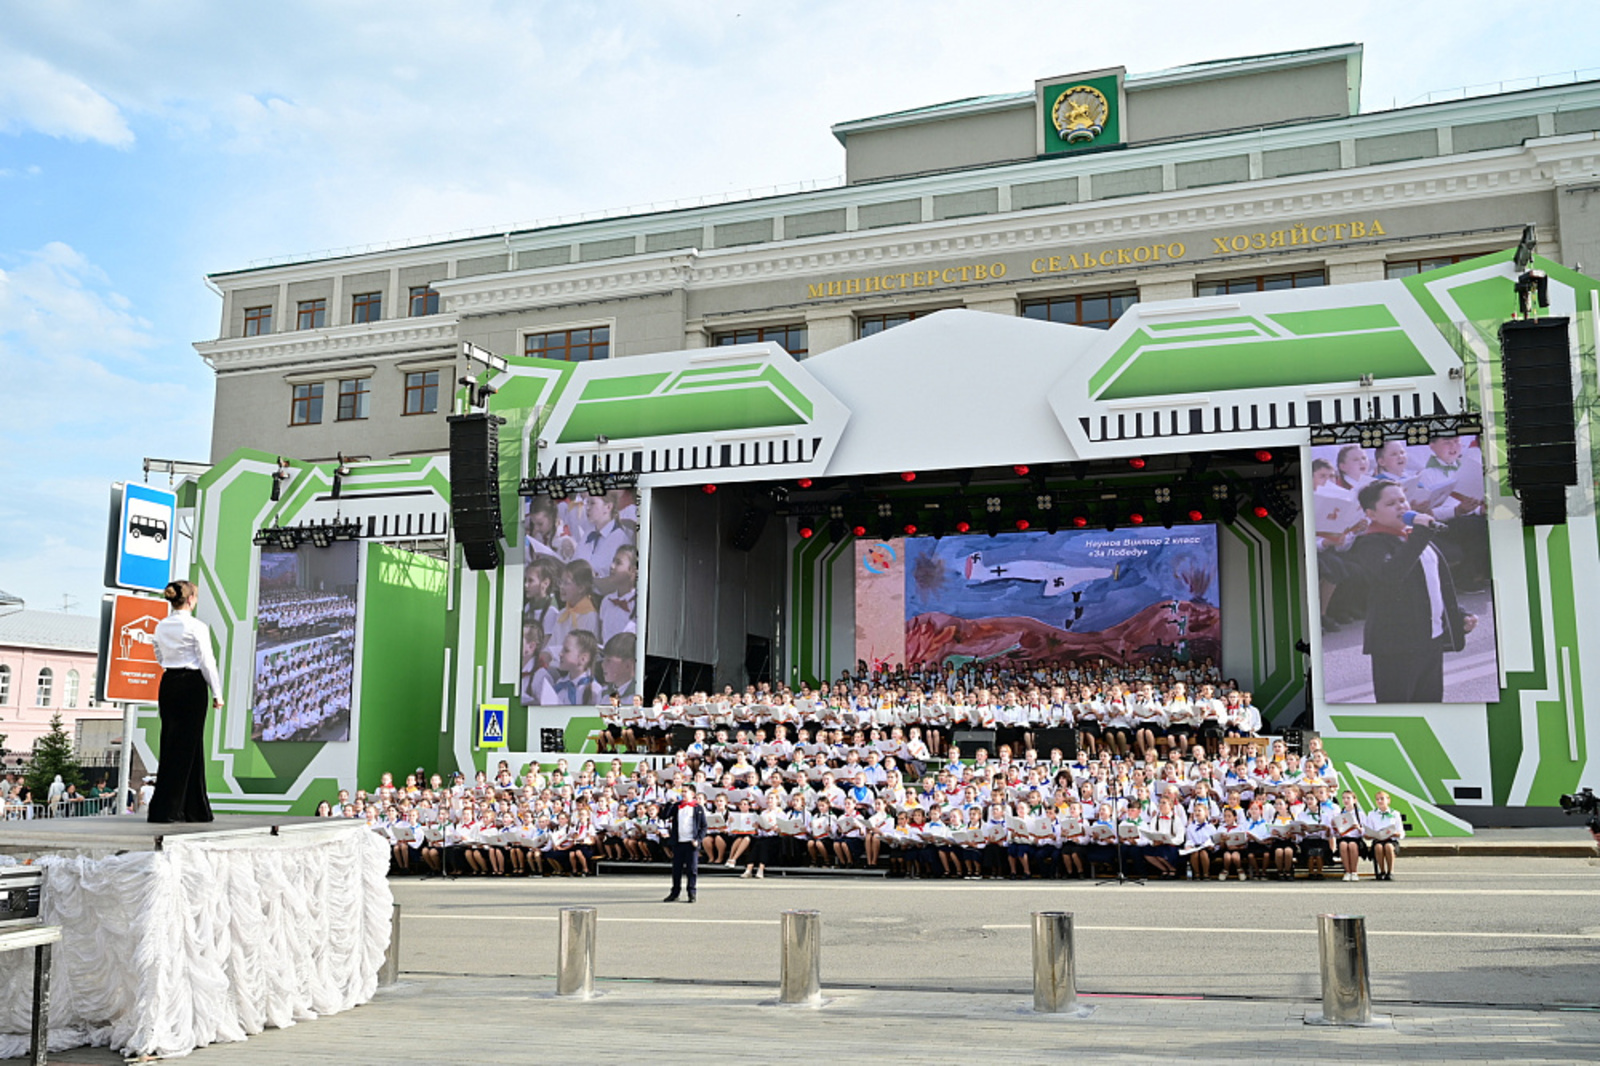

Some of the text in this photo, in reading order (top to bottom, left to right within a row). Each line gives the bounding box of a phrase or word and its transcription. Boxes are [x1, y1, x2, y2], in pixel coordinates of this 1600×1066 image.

[807, 219, 1386, 299] МИНИСТЕРСТВО СЕЛЬСКОГО ХОЗЯЙСТВА
